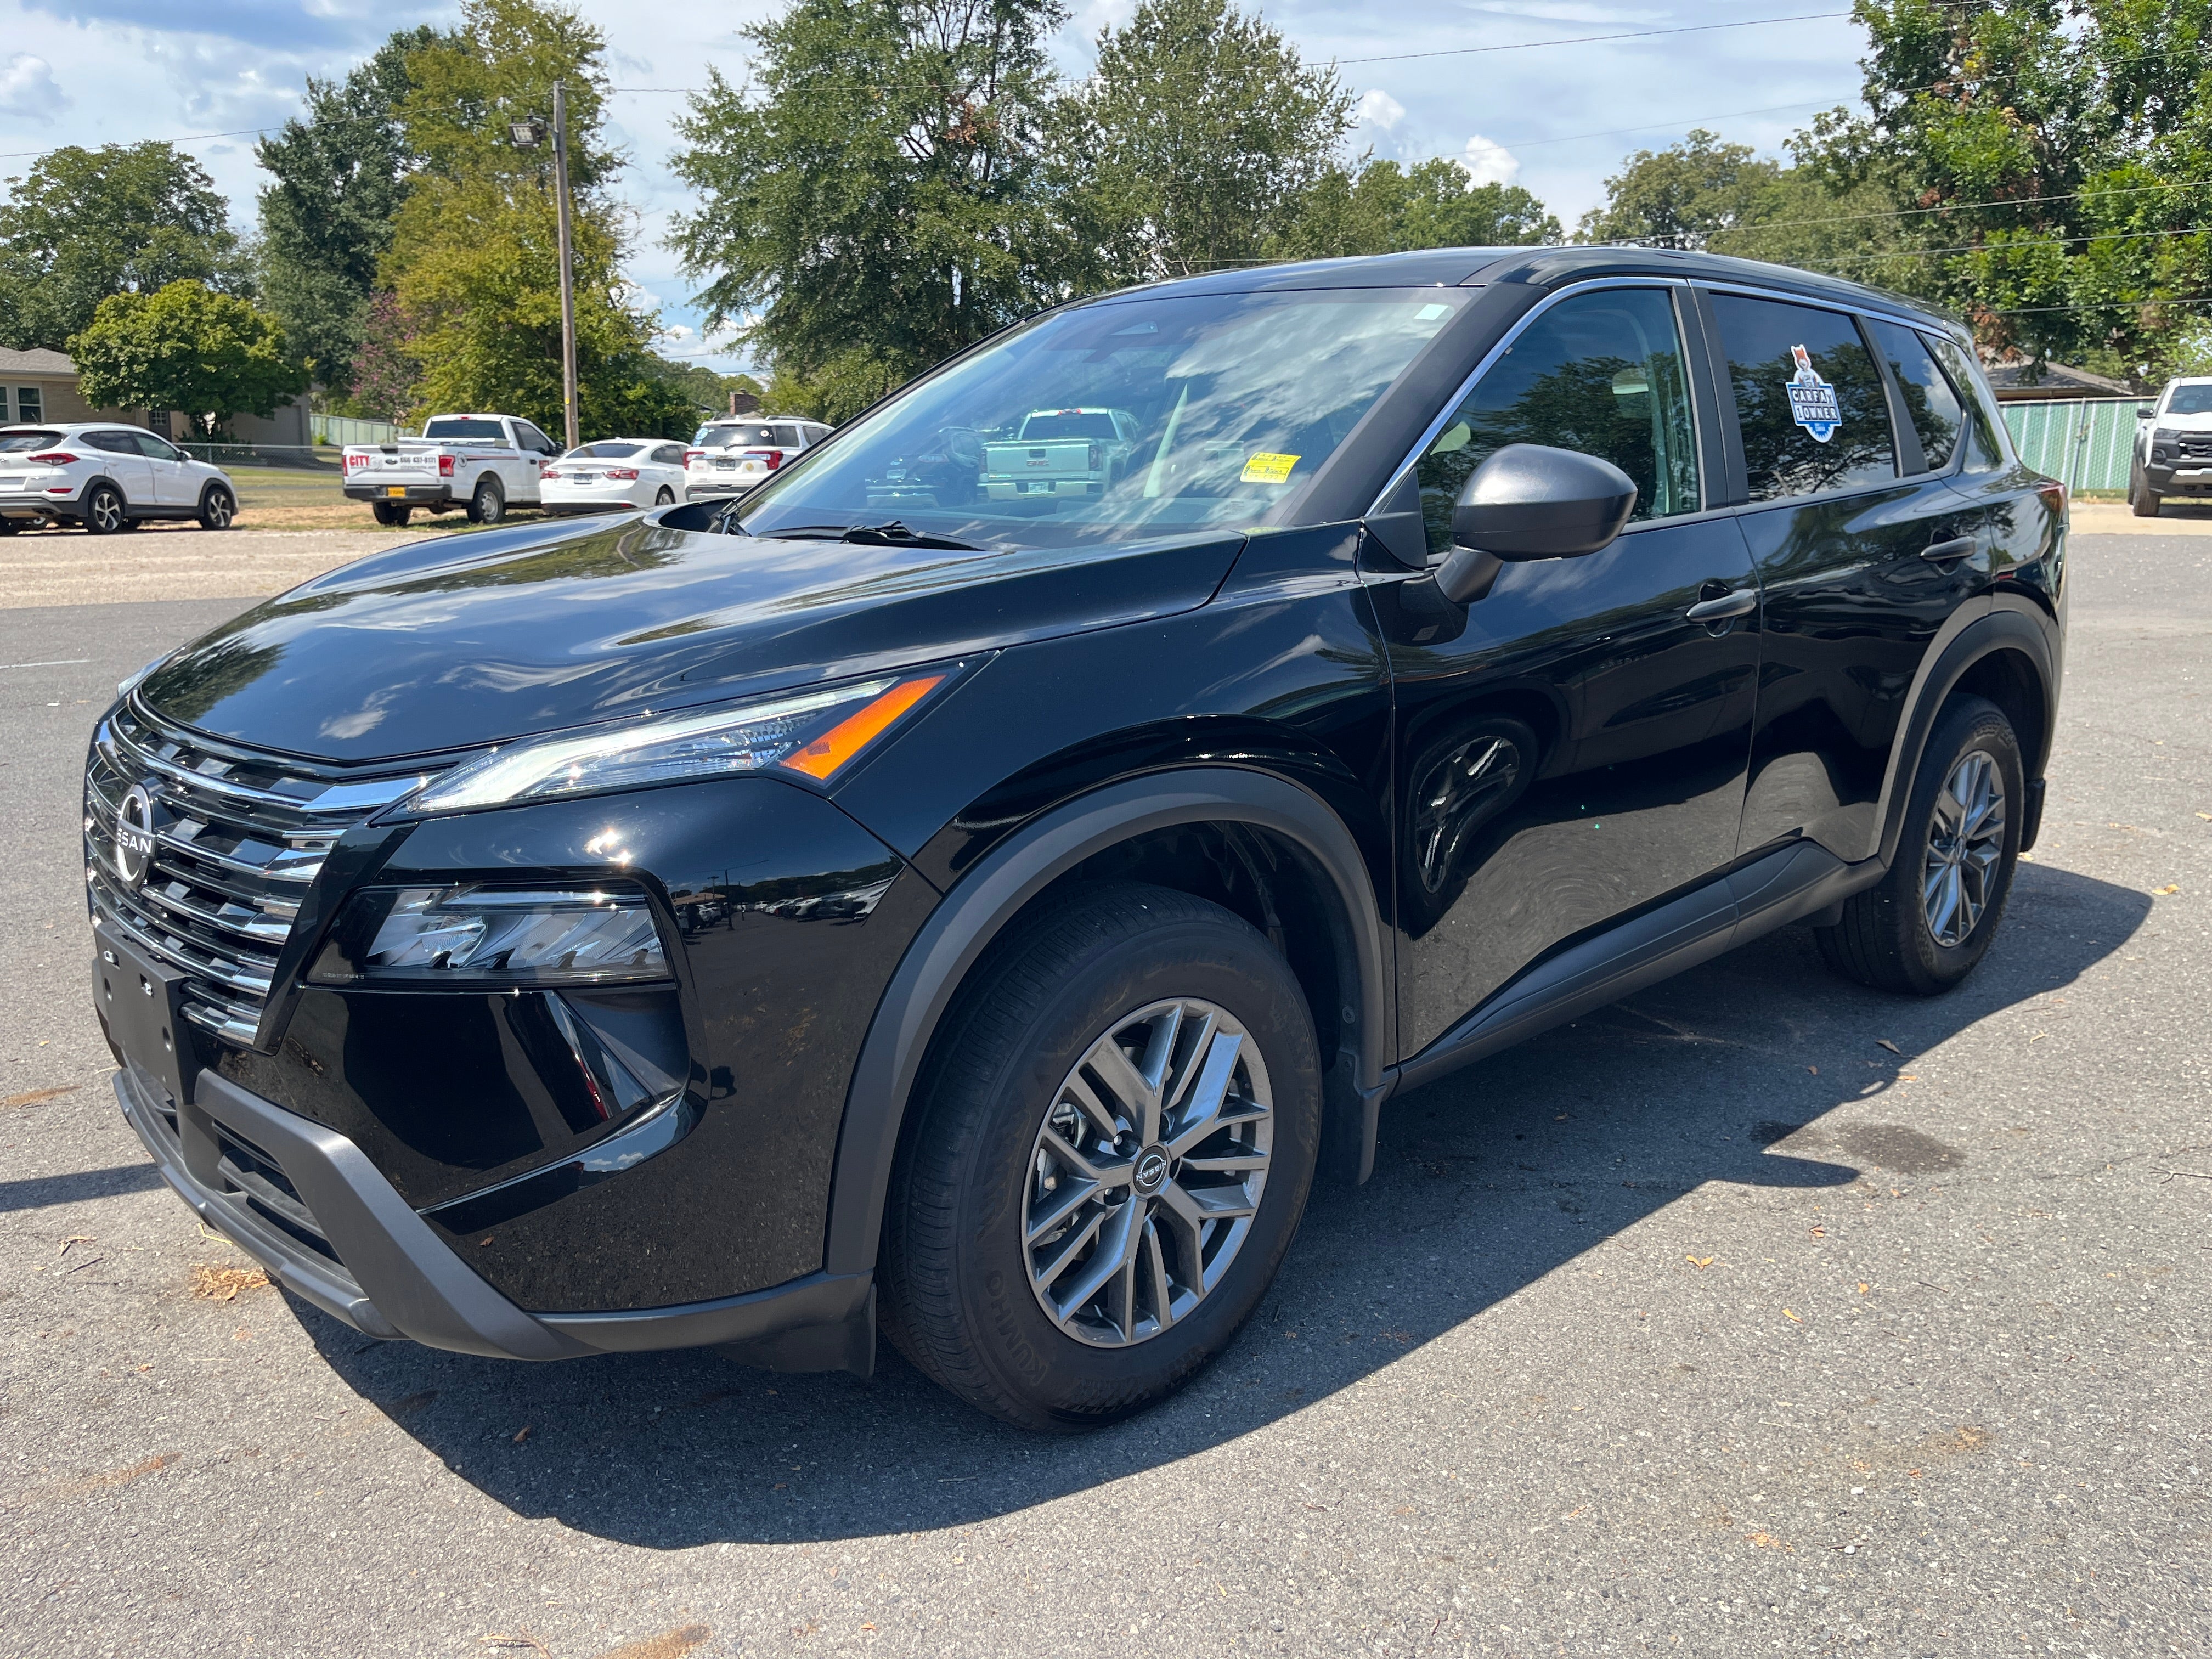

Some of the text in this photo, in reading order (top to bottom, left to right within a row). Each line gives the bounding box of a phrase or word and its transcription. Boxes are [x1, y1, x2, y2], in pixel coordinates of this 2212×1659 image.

[1792, 389, 1833, 404] CARFAX
[1796, 407, 1837, 420] 1 OWNER
[349, 455, 369, 466] CITY
[1136, 1159, 1166, 1181] NISSAN
[988, 1270, 1048, 1387] KUMHO
